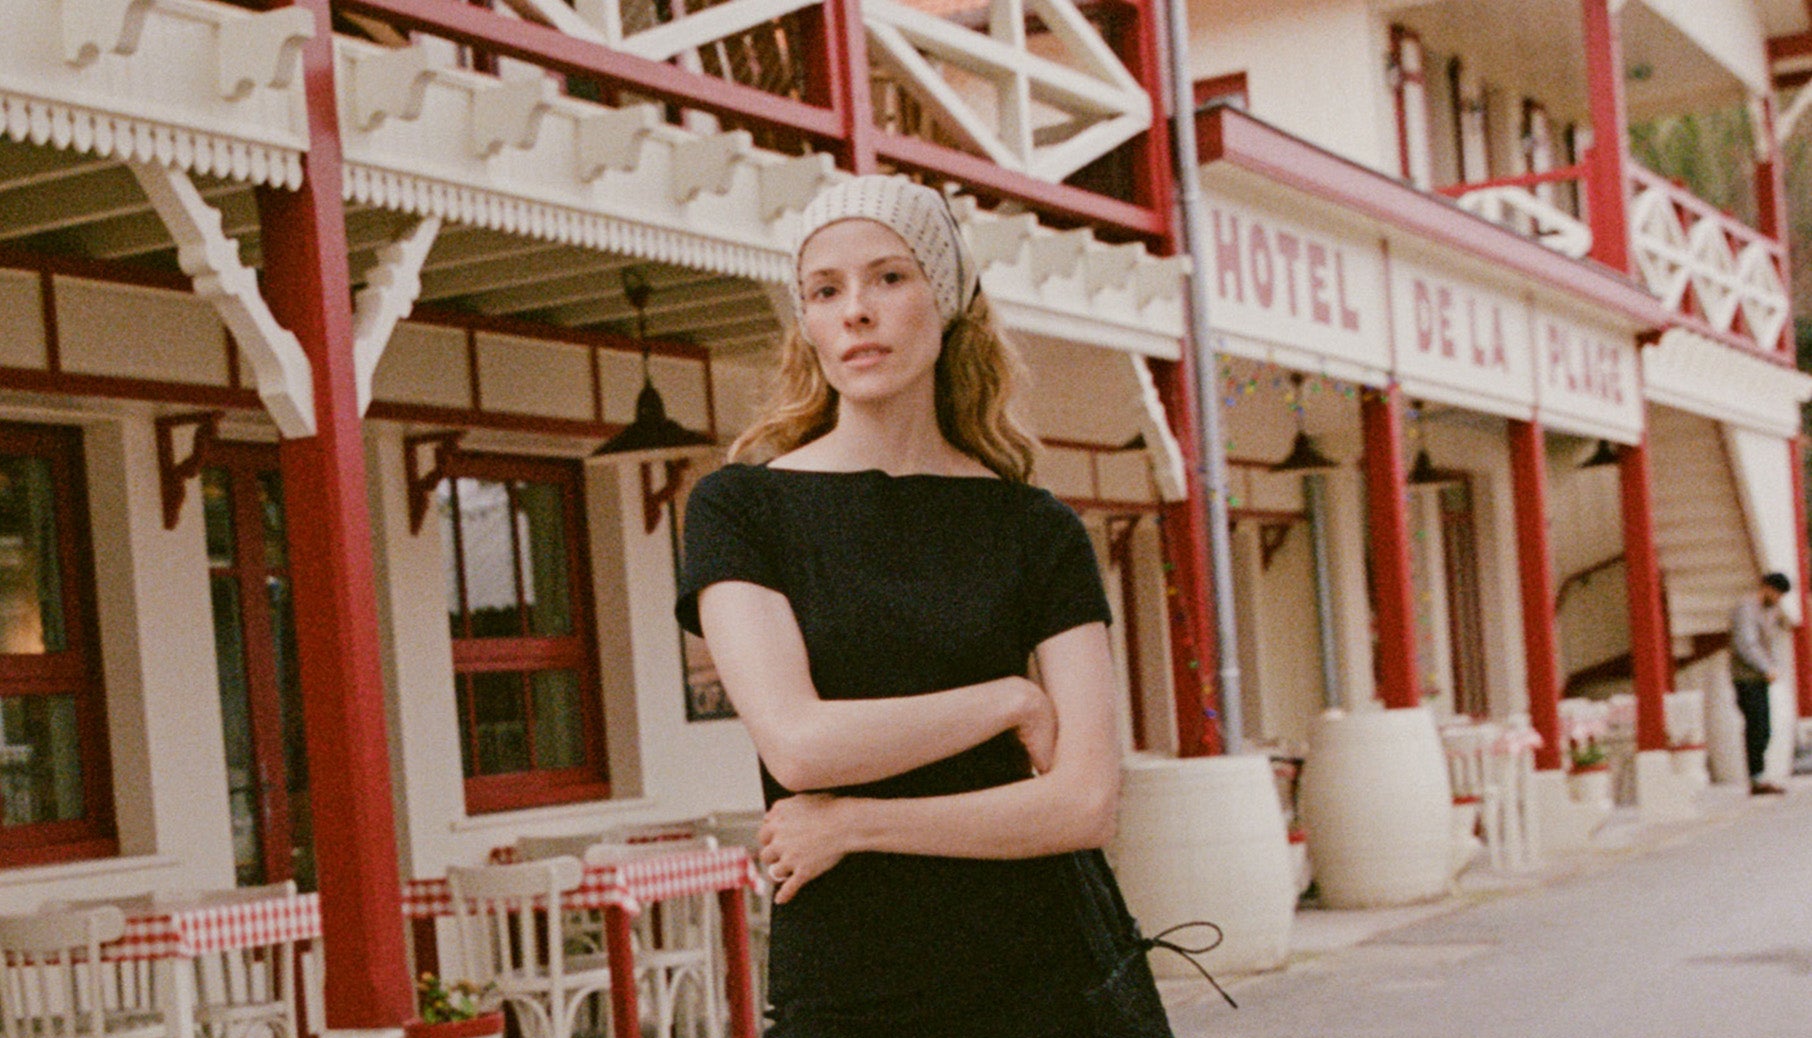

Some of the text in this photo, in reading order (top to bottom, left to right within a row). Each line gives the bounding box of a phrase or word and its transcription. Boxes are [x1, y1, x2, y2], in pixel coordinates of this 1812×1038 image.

[1211, 208, 1360, 332] HOTEL
[1412, 277, 1457, 360] DE
[1466, 298, 1507, 371] LA
